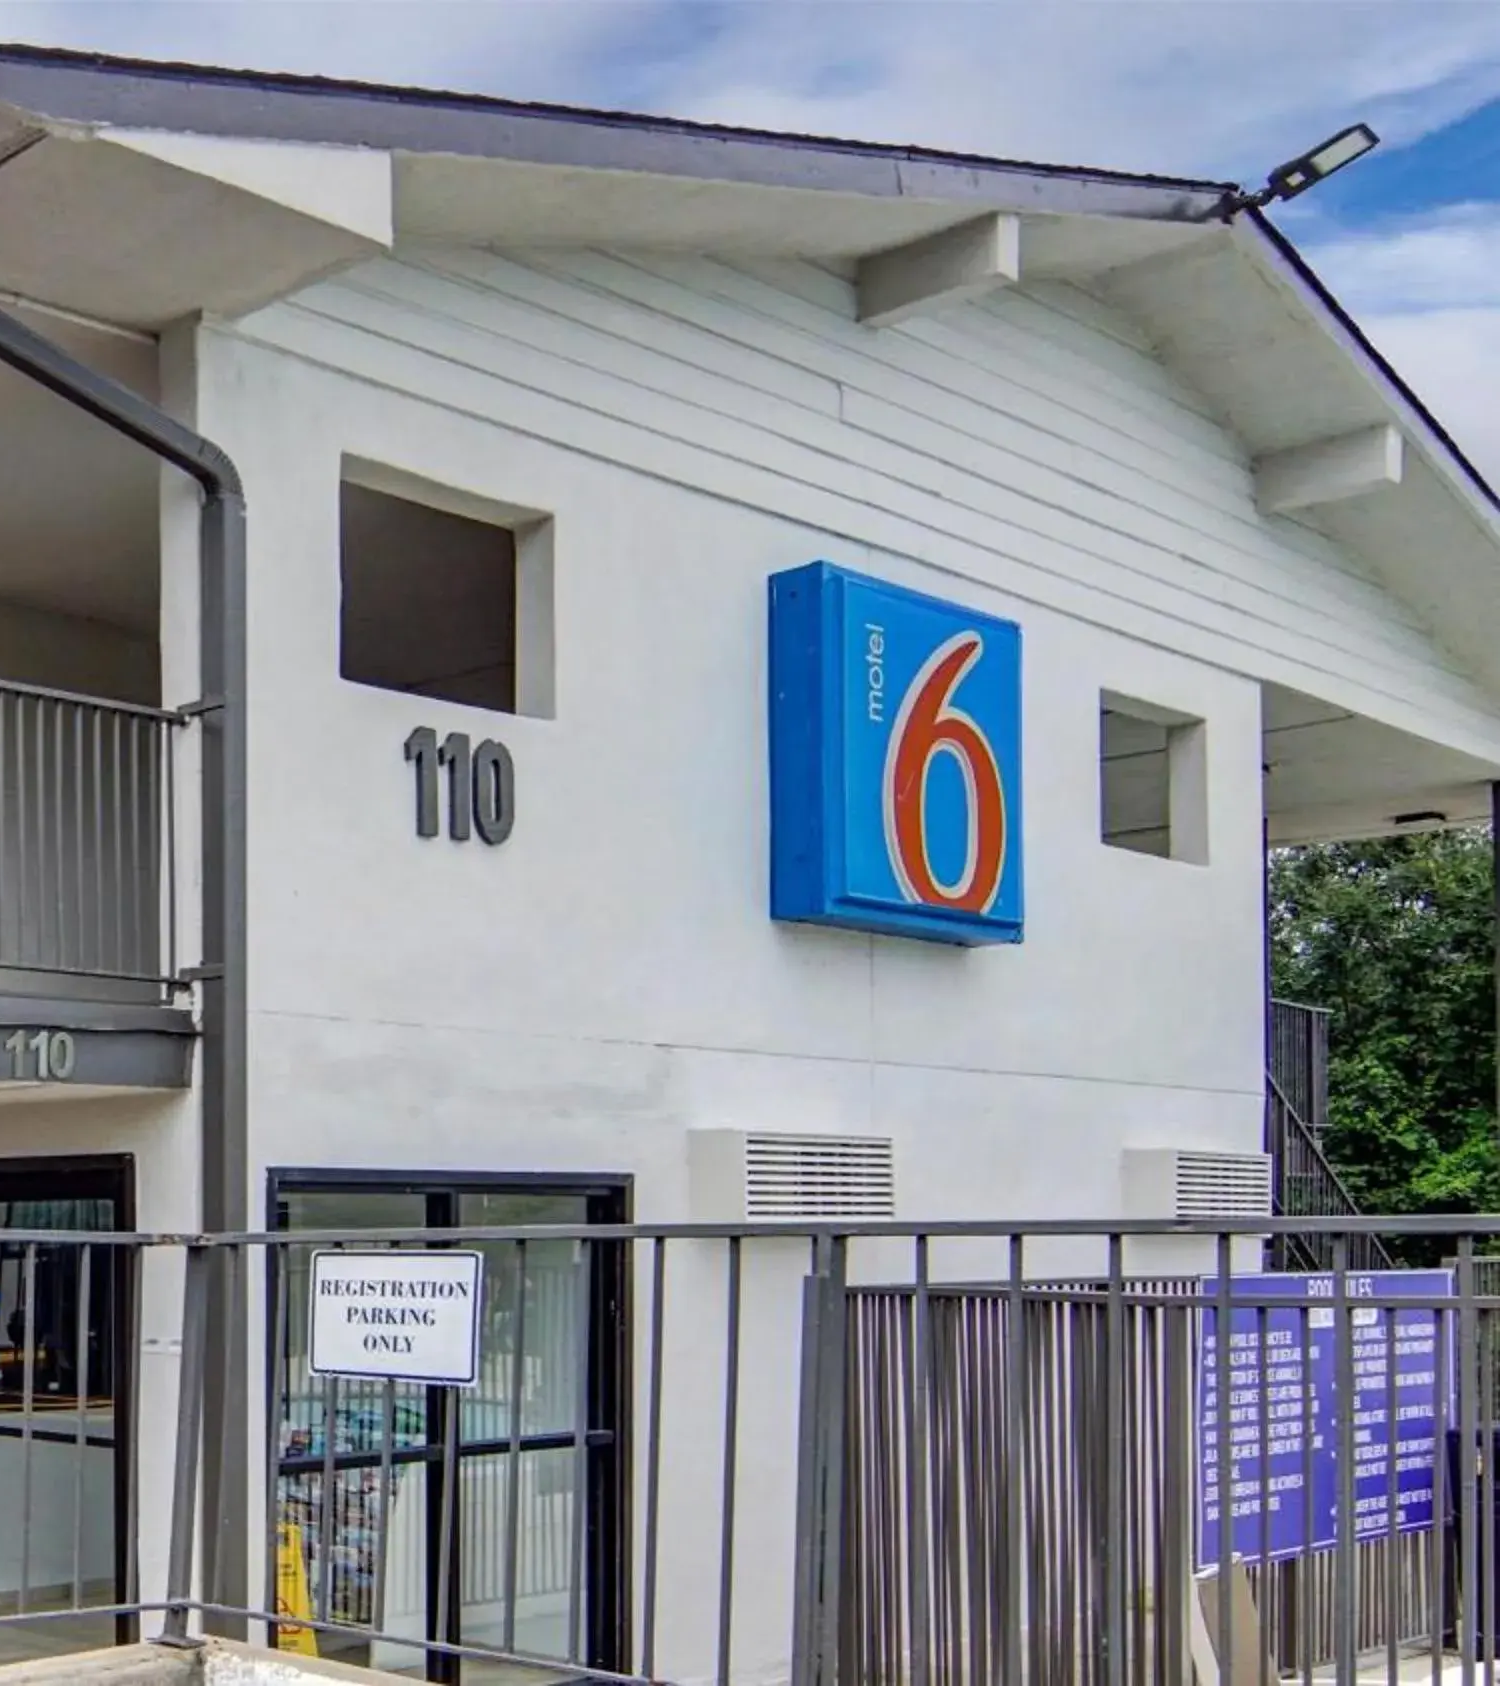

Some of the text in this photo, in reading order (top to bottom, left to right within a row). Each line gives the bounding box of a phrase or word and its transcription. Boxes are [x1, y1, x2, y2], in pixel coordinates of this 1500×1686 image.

[865, 623, 885, 722] motel
[404, 726, 515, 846] 110
[882, 630, 1007, 916] 6
[4, 1030, 74, 1079] 110
[320, 1279, 470, 1298] REGISTRATION
[1345, 1278, 1373, 1297] ULES
[346, 1306, 436, 1327] PARKING
[363, 1335, 416, 1354] ONLY
